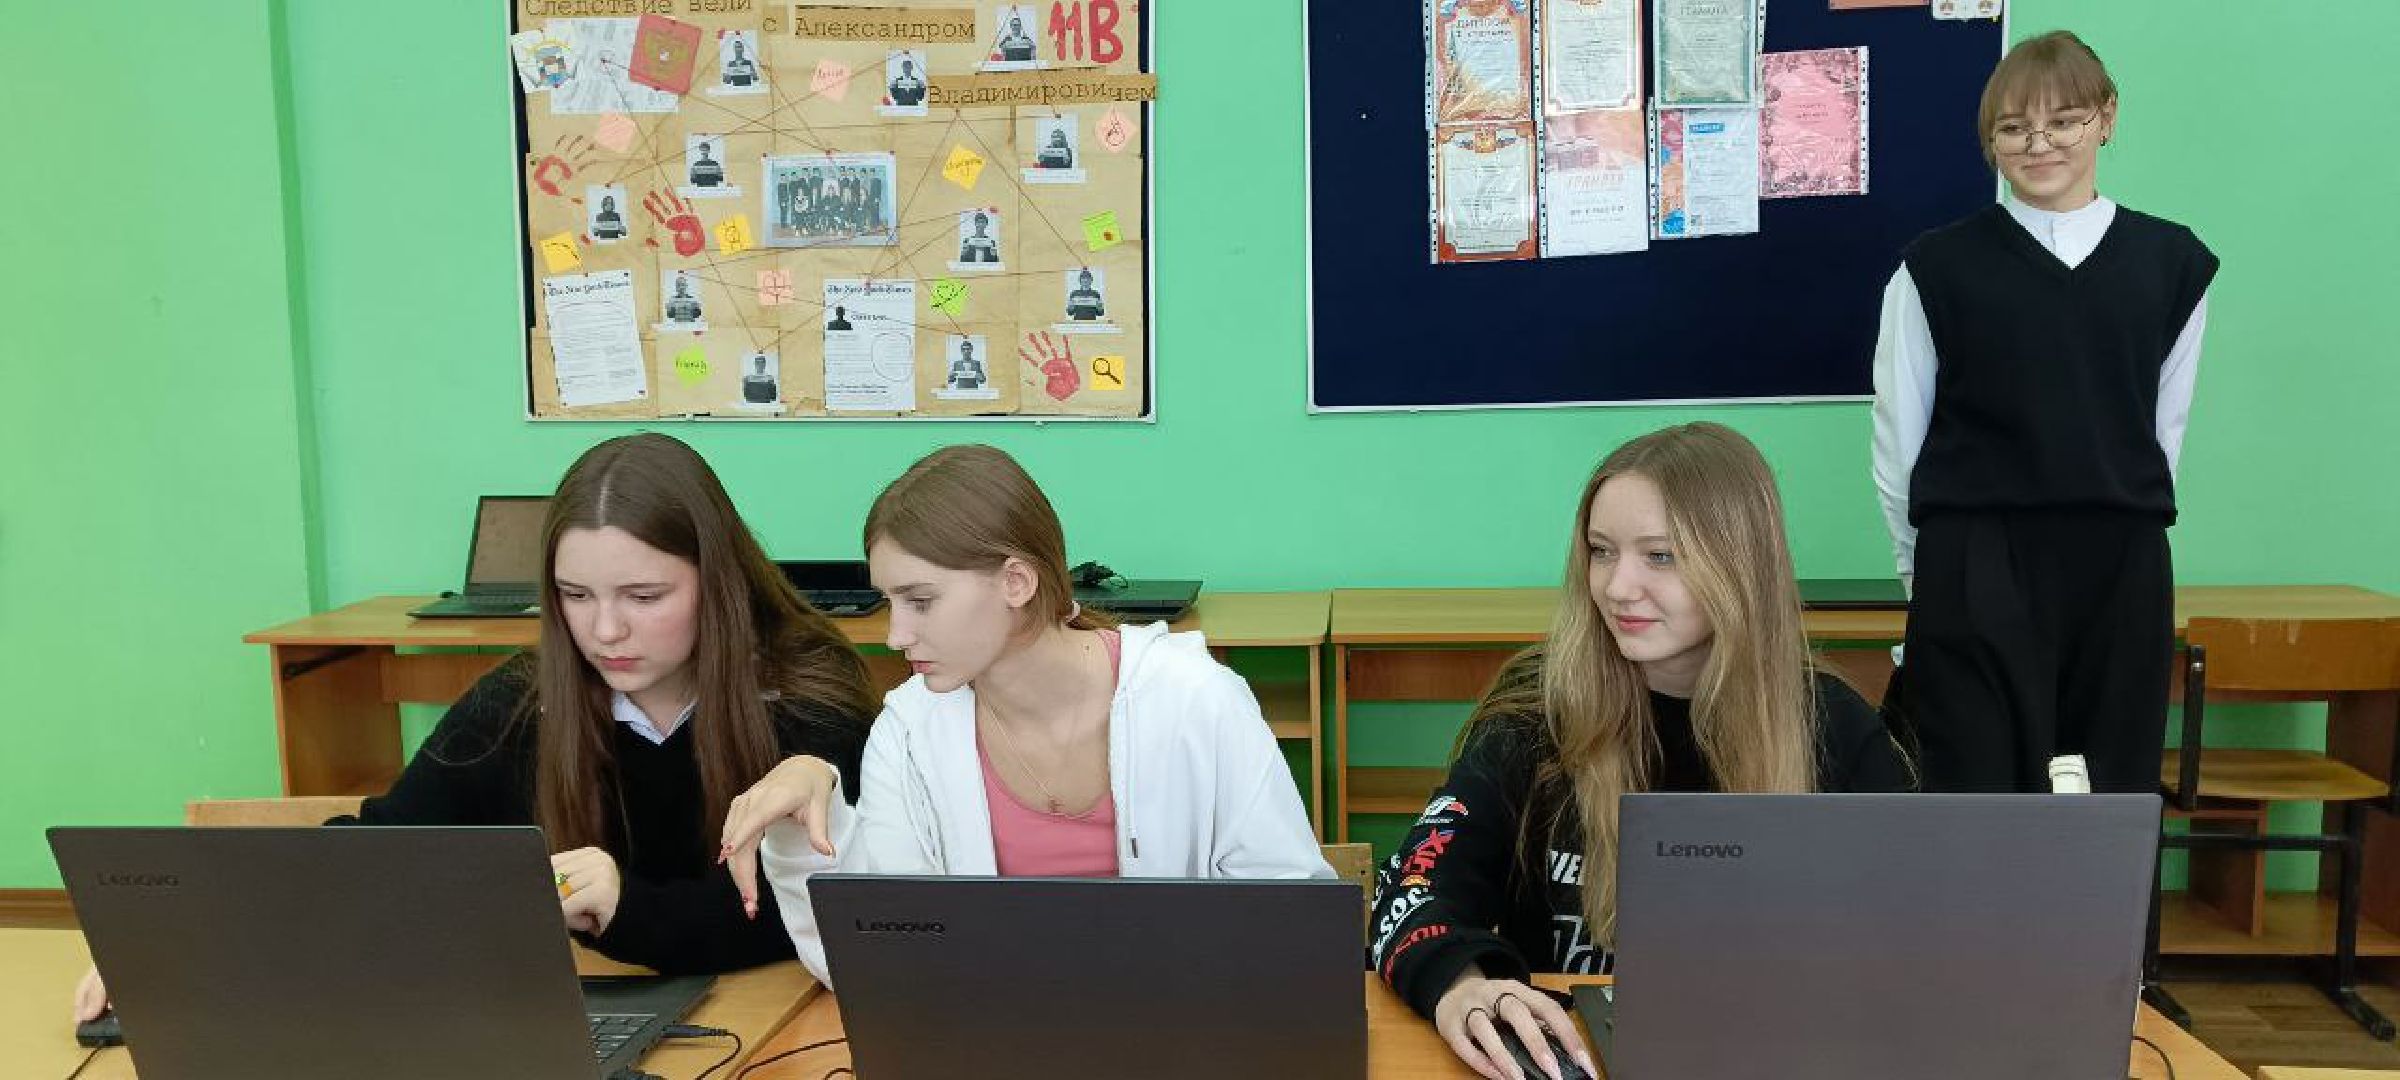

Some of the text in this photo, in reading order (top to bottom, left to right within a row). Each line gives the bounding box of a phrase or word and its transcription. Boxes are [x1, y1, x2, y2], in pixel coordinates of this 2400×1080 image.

[526, 0, 753, 16] Следствие вели
[762, 17, 975, 43] с Александром
[927, 84, 1156, 105] Владимировичем
[1656, 840, 1744, 858] Lenovo
[855, 918, 946, 933] Lenovo
